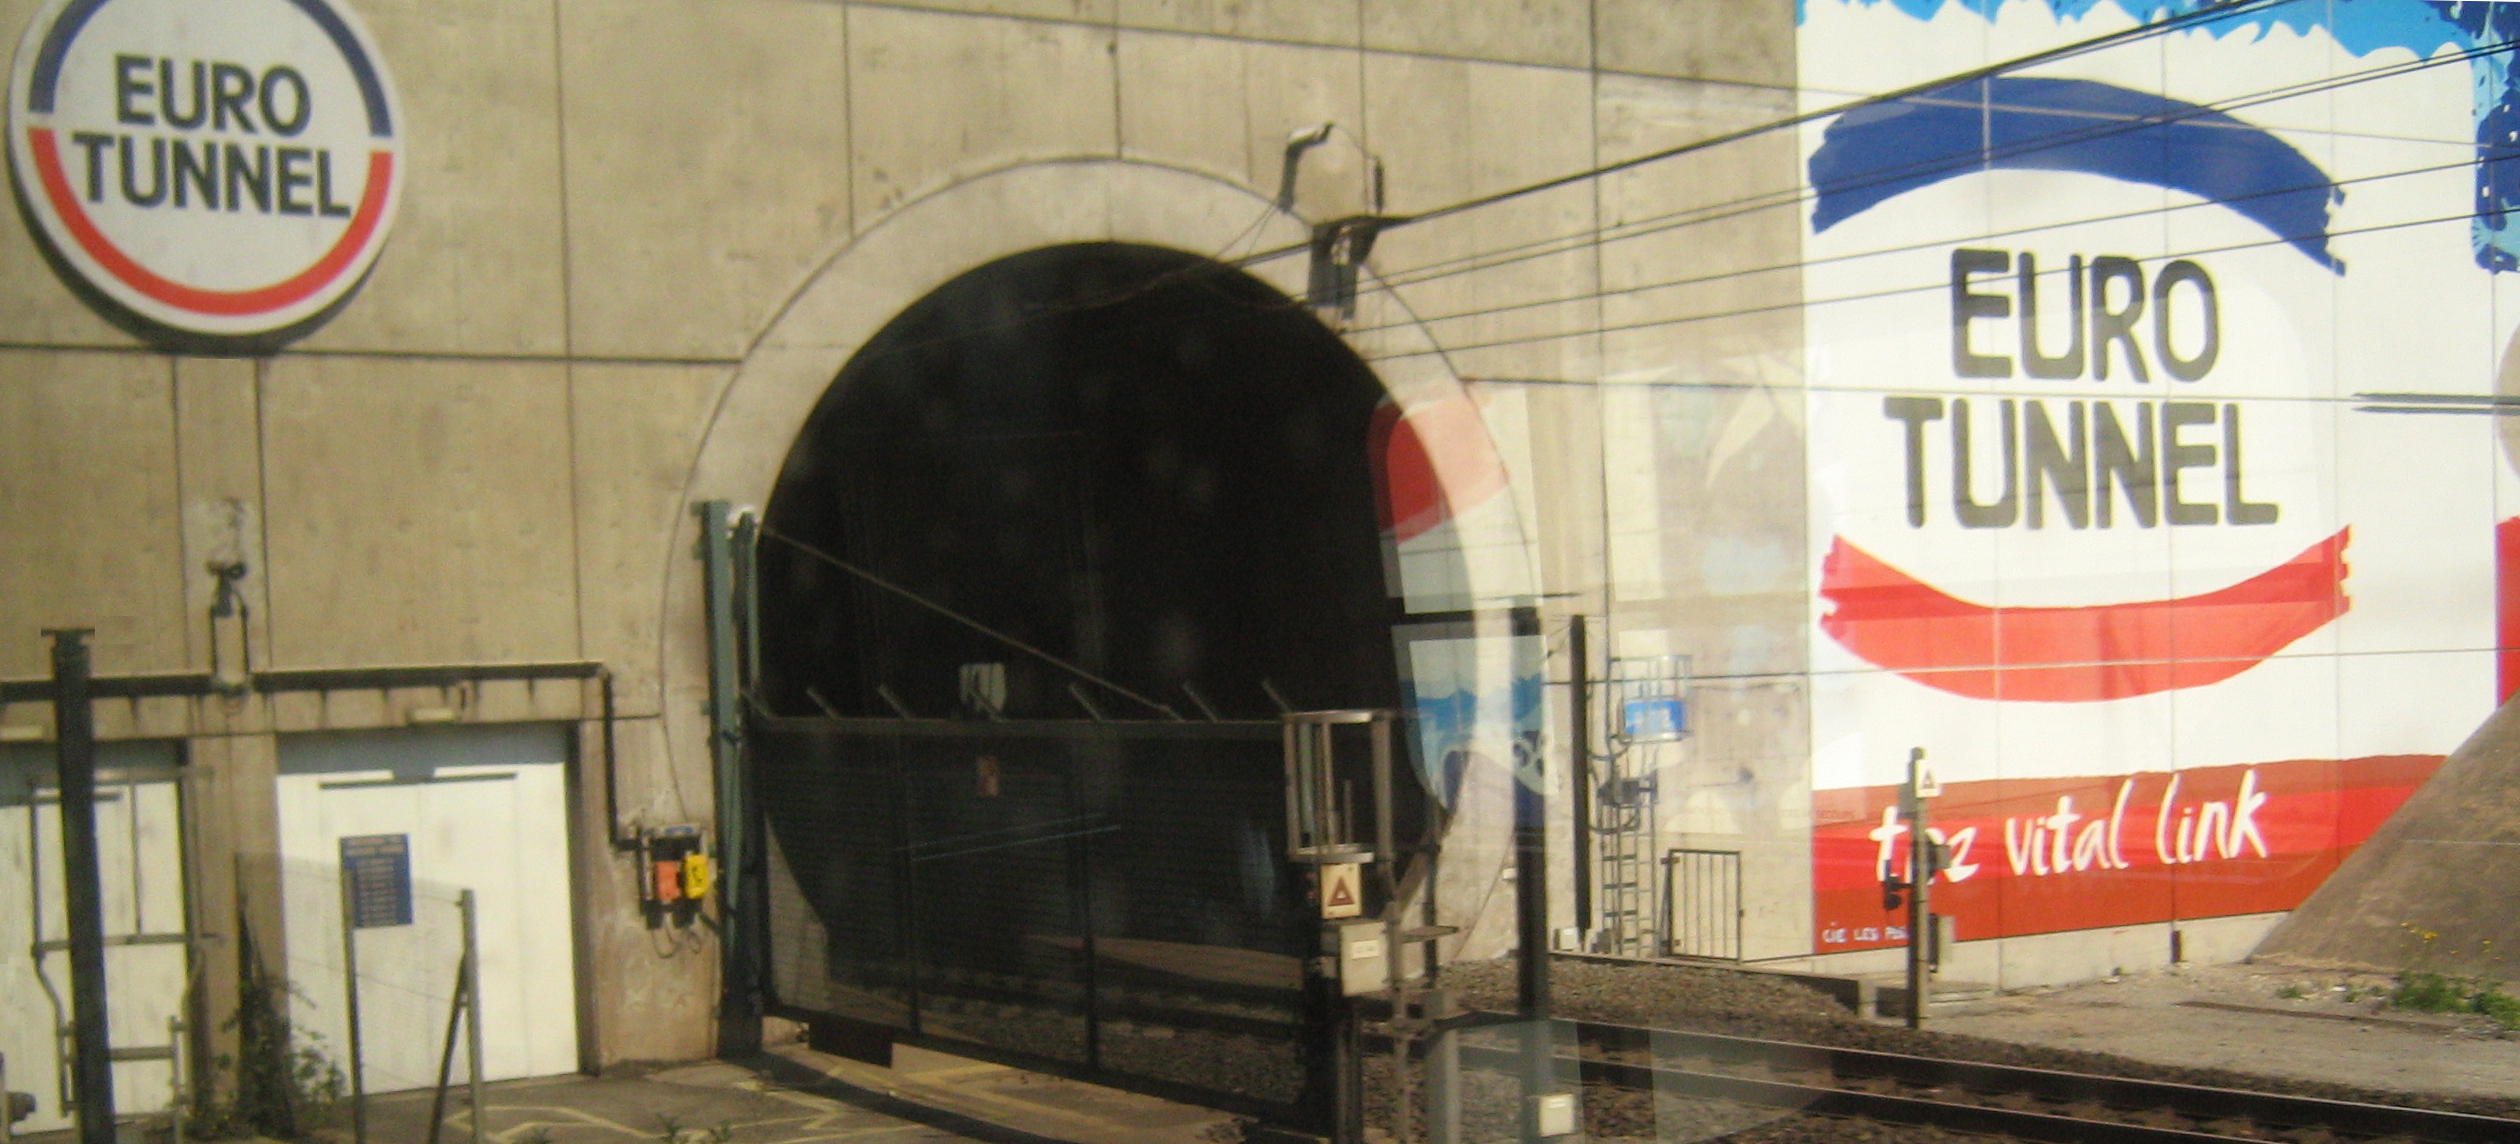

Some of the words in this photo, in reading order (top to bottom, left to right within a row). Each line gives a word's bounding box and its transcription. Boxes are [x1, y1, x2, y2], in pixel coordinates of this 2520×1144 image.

[116, 53, 312, 137] EURO
[72, 130, 352, 218] TUNNEL
[1951, 248, 2220, 383] EURO
[1883, 396, 2280, 530] TUNNEL
[2005, 777, 2134, 876] vital
[2154, 768, 2269, 865] link
